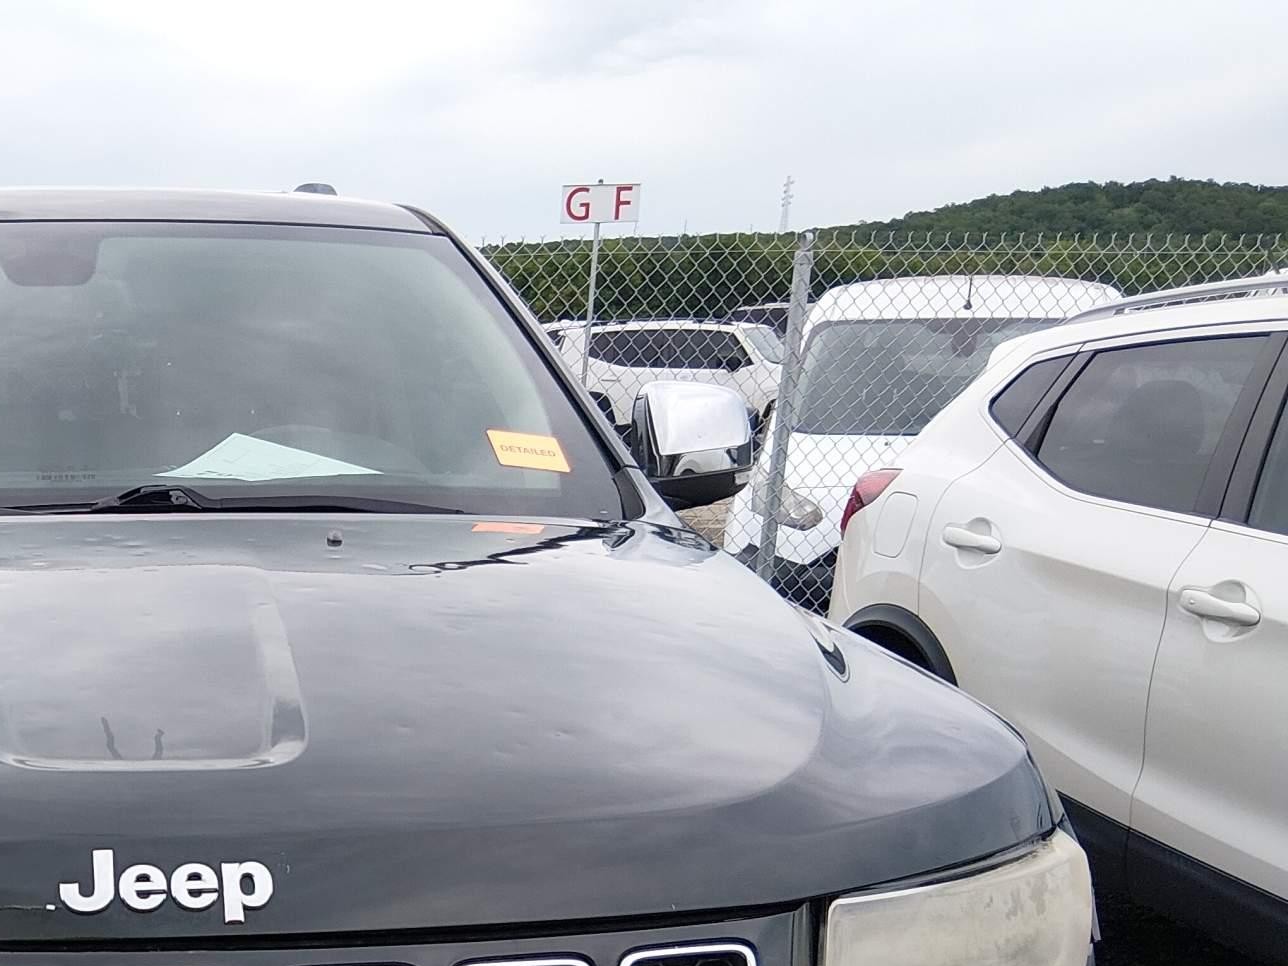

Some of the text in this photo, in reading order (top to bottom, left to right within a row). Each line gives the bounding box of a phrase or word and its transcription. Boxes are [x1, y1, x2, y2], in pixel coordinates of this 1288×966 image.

[565, 186, 634, 221] G F
[499, 444, 557, 457] DETAILED
[58, 848, 275, 925] Jeep
